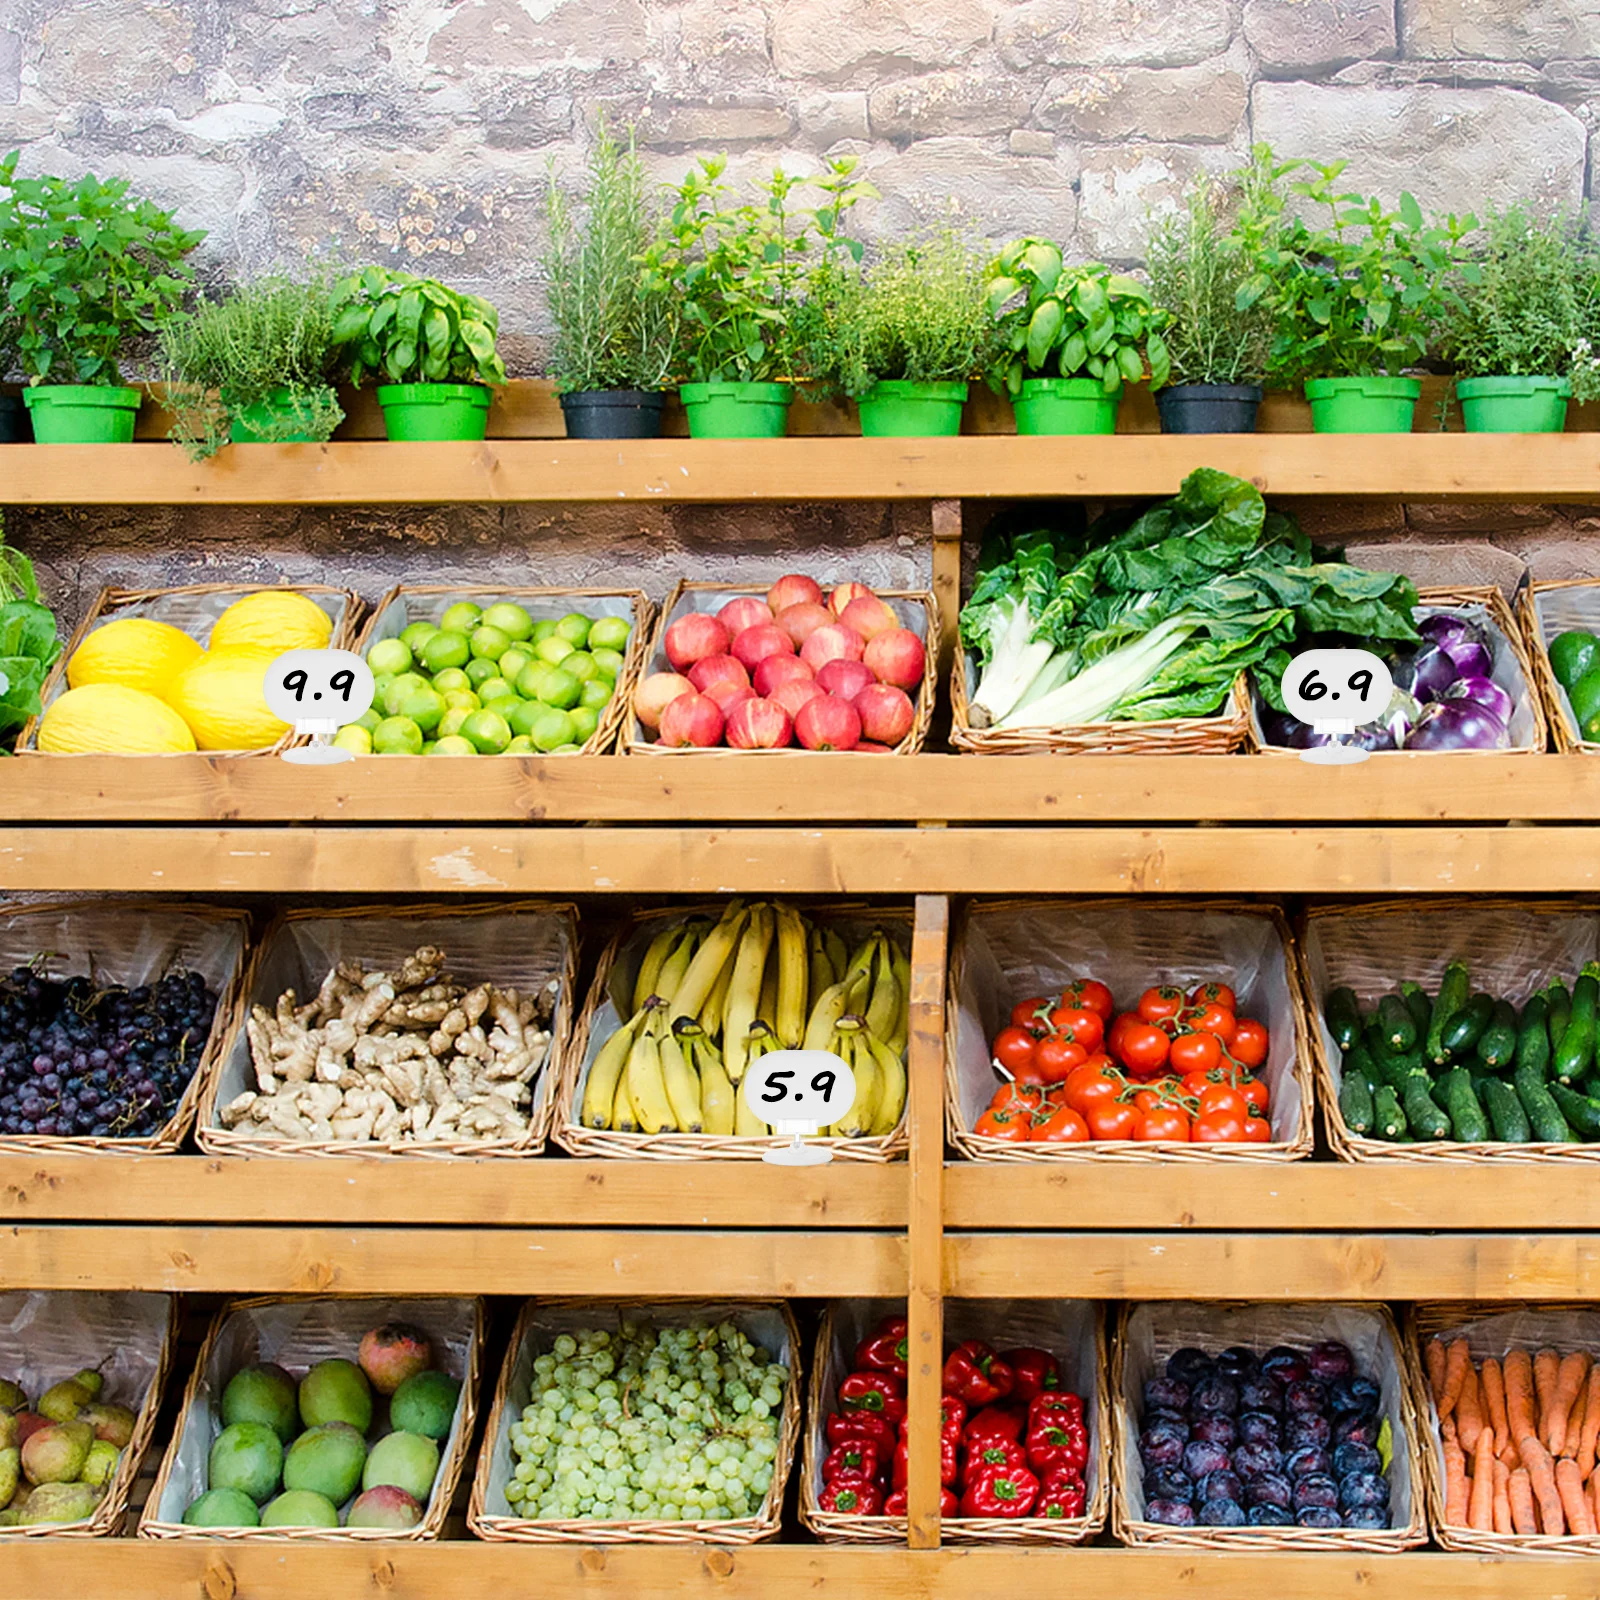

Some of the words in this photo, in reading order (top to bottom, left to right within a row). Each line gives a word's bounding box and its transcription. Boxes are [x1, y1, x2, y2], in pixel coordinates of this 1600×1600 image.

[282, 669, 356, 702] 9.9
[1298, 669, 1374, 702] 6.9
[761, 1070, 837, 1103] 5.9
